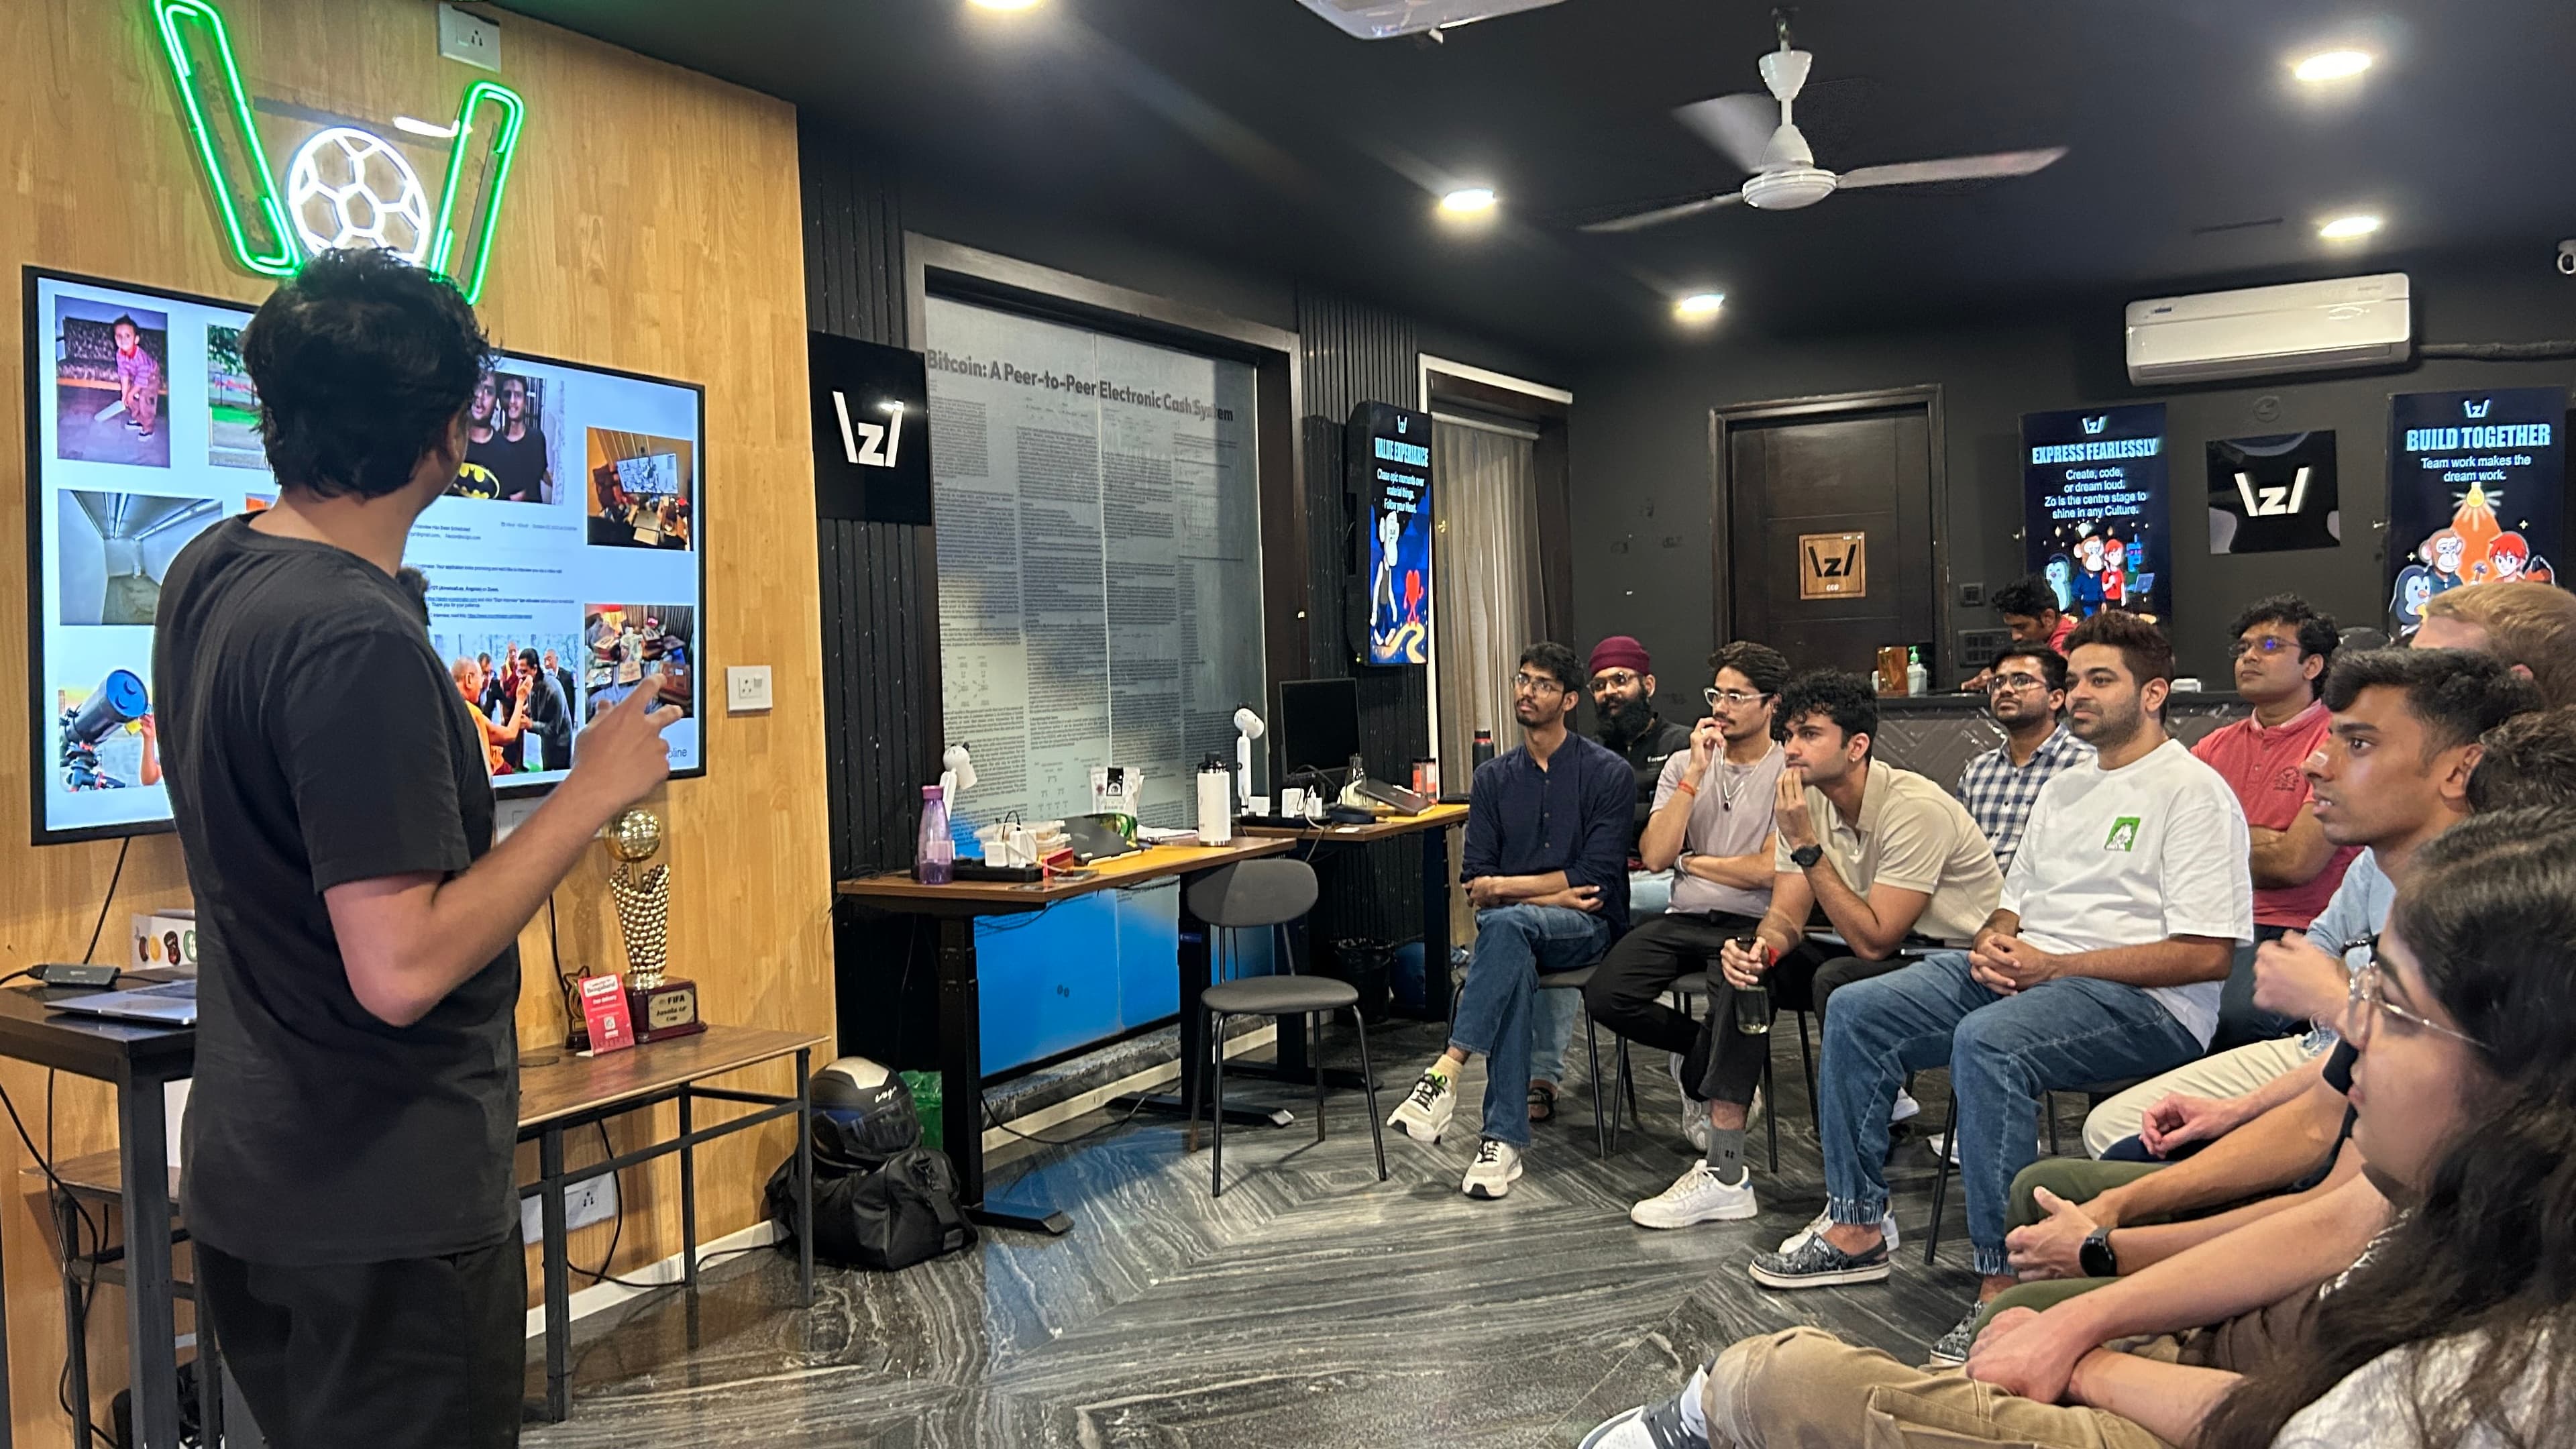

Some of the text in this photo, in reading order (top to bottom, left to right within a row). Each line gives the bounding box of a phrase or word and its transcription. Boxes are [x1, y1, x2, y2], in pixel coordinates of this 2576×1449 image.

[927, 349, 987, 378] Bitcoin:
[989, 360, 1002, 380] A
[1004, 362, 1097, 396] Peer-to-Peer
[1099, 380, 1161, 409] Electronic
[1163, 392, 1192, 414] Cash
[2406, 423, 2551, 451] BUILD TOGETHER
[1375, 437, 1394, 461] VALUE
[2032, 438, 2158, 464] EXPRESS FEARLESSLY
[2420, 454, 2532, 469] Team work makes the
[2065, 467, 2123, 480] Create, code,
[2443, 469, 2507, 482] dream work.
[2064, 480, 2126, 493] or dream loud.
[2044, 491, 2147, 506] Zo is the centre stage to
[2052, 504, 2139, 519] shine in any Culture.
[667, 994, 685, 1004] FIFA
